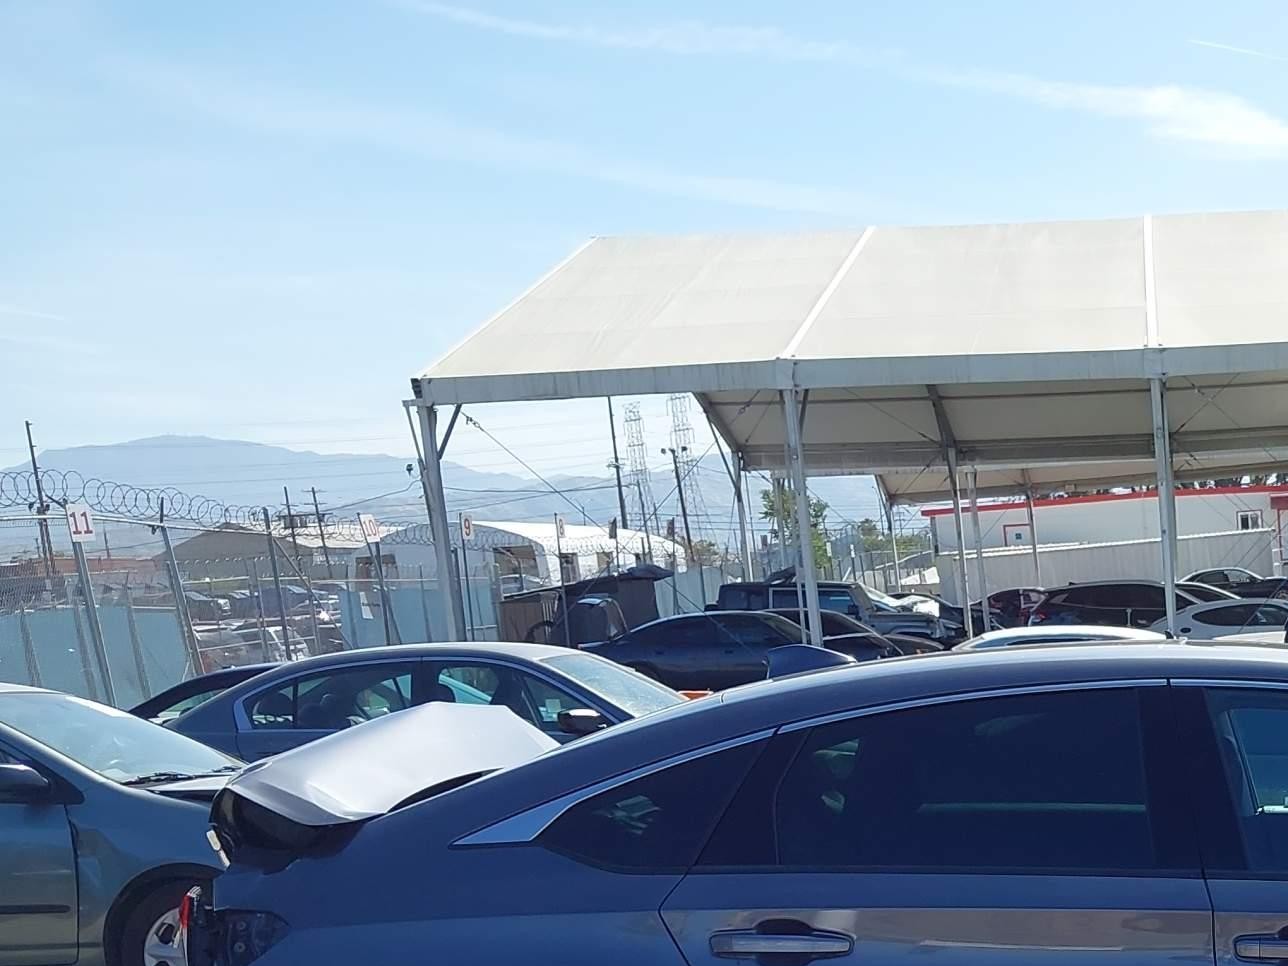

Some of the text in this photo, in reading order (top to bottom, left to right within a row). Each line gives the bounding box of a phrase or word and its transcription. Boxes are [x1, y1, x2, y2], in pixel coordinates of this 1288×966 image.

[69, 511, 94, 535] 11
[363, 519, 377, 537] 10
[464, 518, 471, 536] 9
